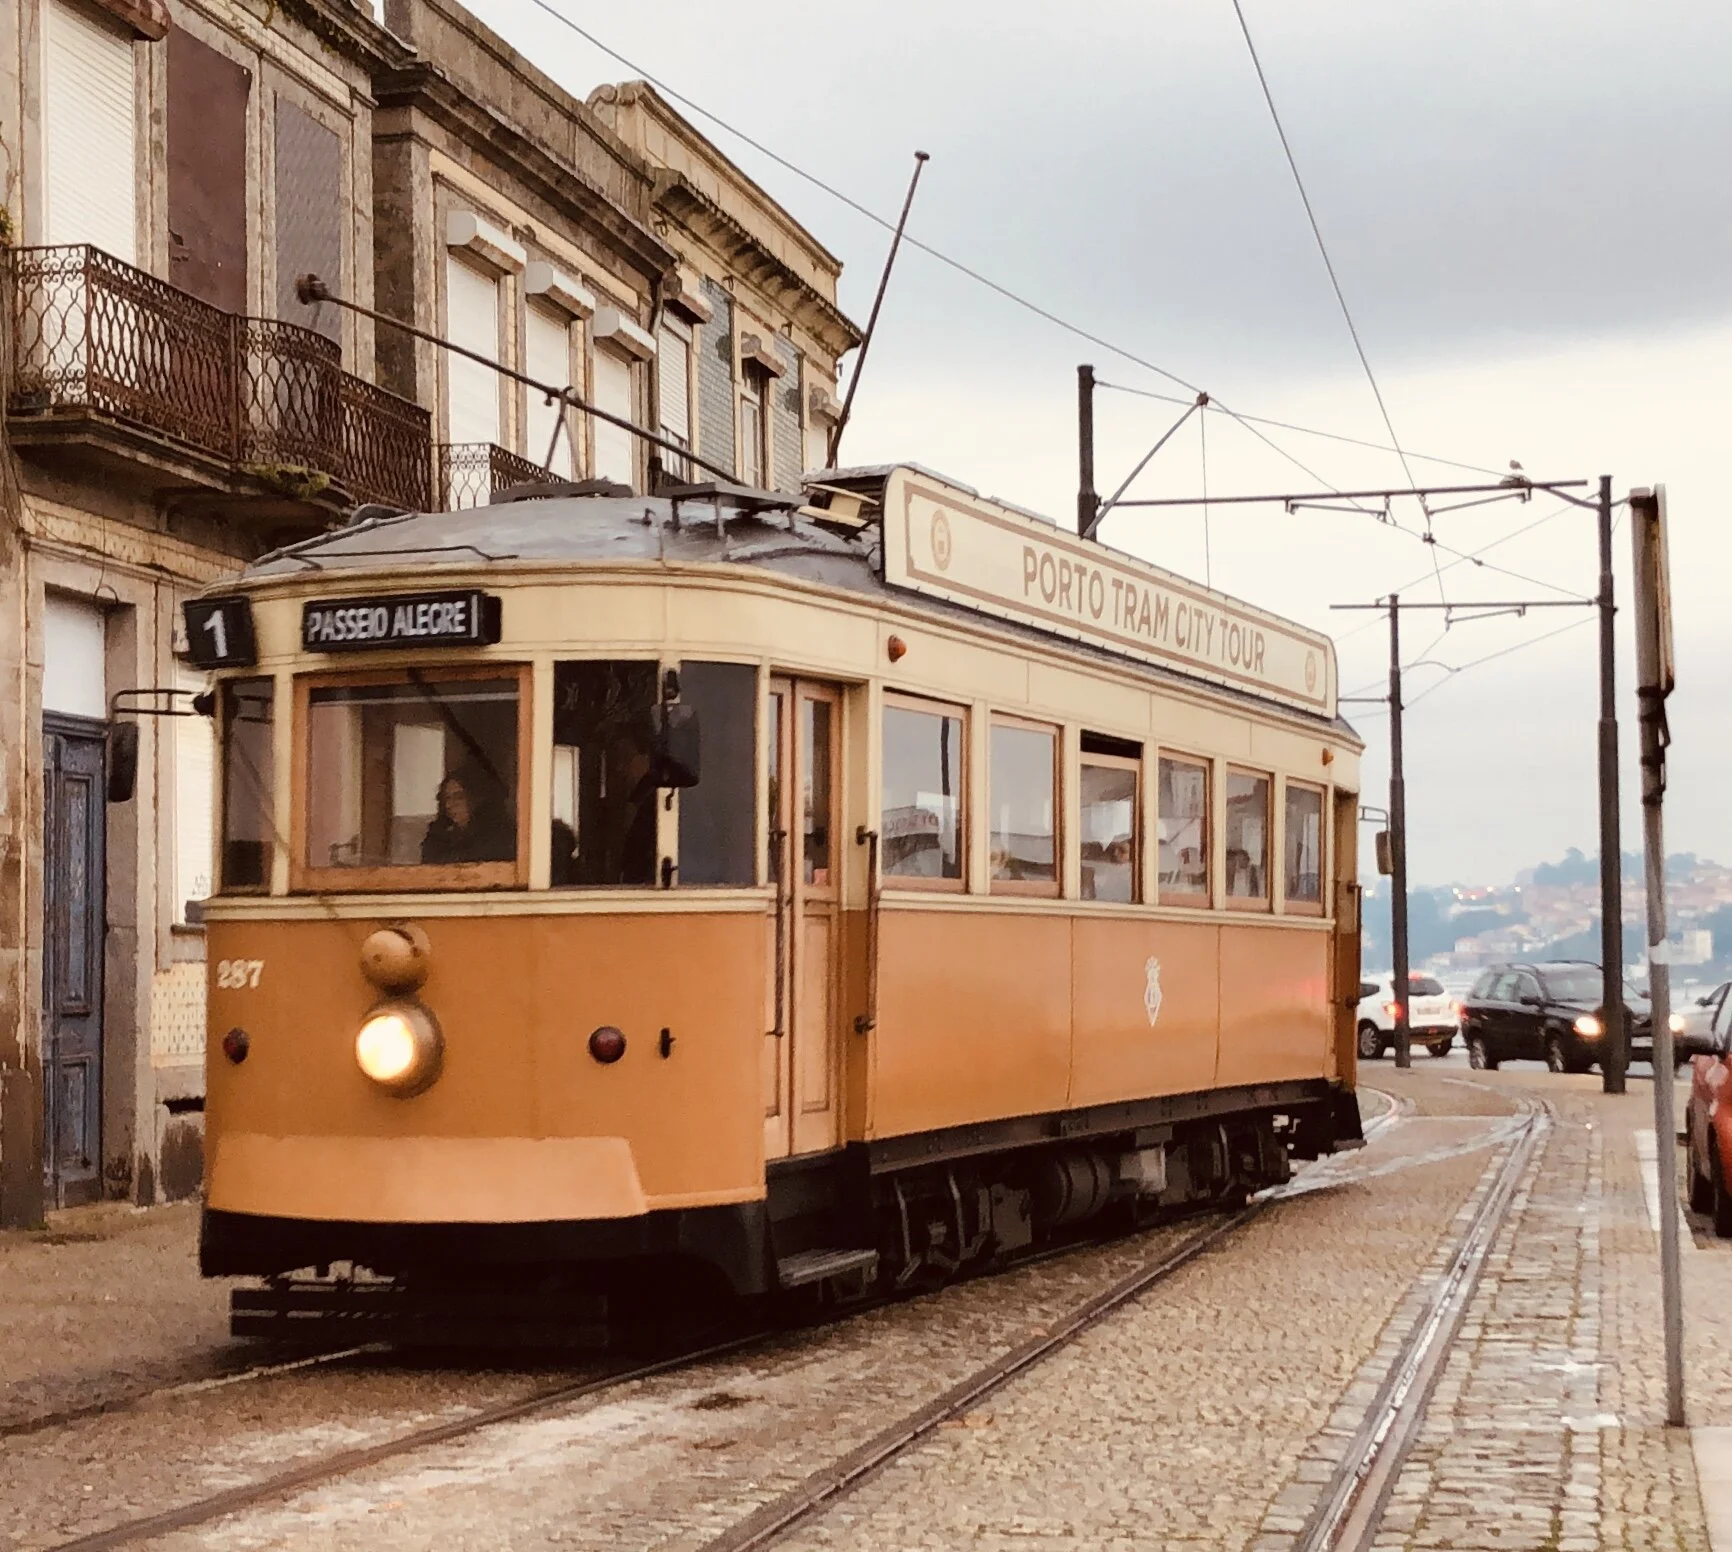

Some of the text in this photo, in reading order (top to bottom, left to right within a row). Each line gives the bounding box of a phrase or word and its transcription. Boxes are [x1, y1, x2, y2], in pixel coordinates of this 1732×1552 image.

[307, 600, 467, 643] PASSEIO ALEGRE
[1022, 545, 1265, 674] PORTO TRAM CITY TOUR
[203, 609, 229, 658] 1
[216, 958, 265, 989] 287
